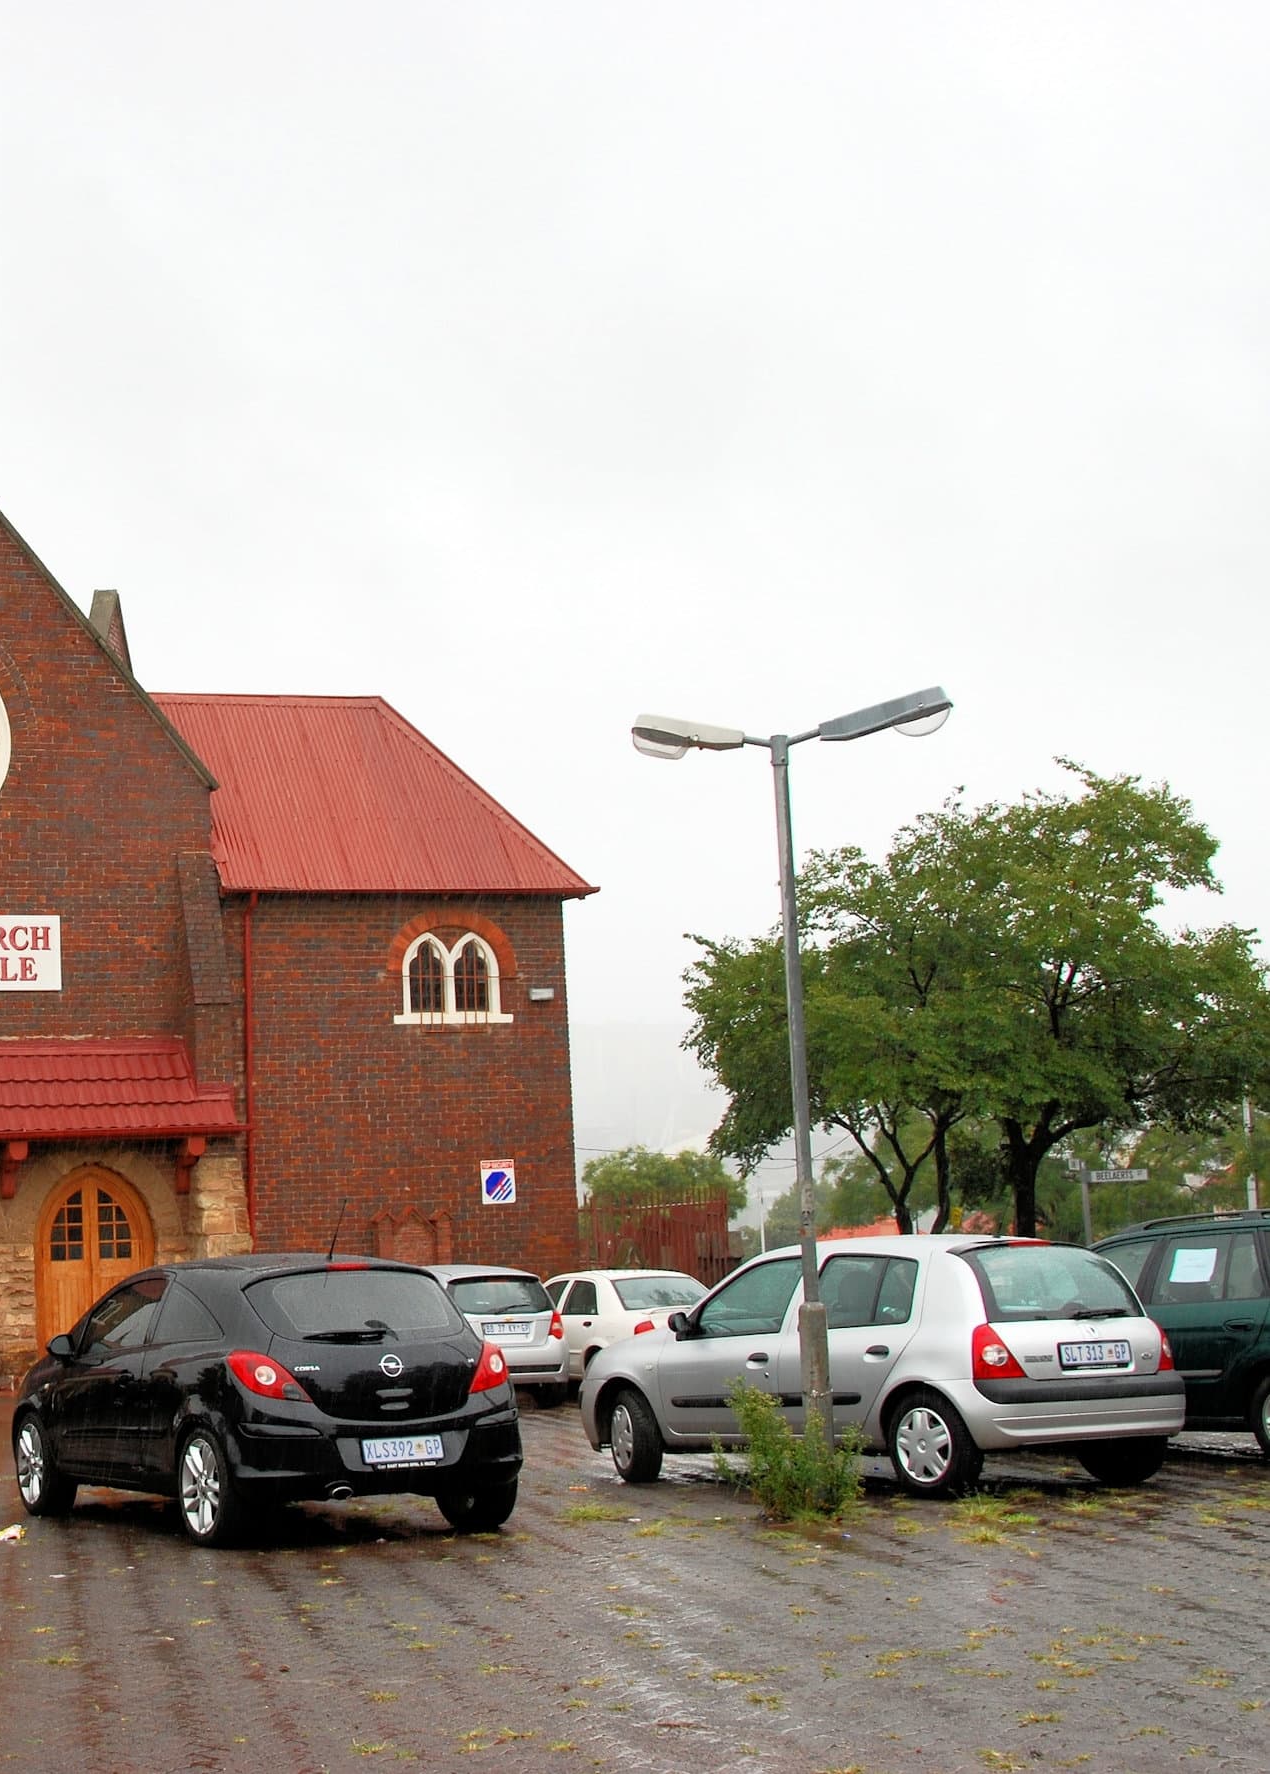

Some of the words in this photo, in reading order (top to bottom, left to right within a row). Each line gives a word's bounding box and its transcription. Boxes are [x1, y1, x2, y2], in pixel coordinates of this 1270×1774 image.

[1064, 1346, 1083, 1362] SLT
[1085, 1345, 1104, 1361] 313
[1114, 1344, 1126, 1359] GP
[364, 1441, 415, 1459] XLS392
[425, 1439, 440, 1455] GP
